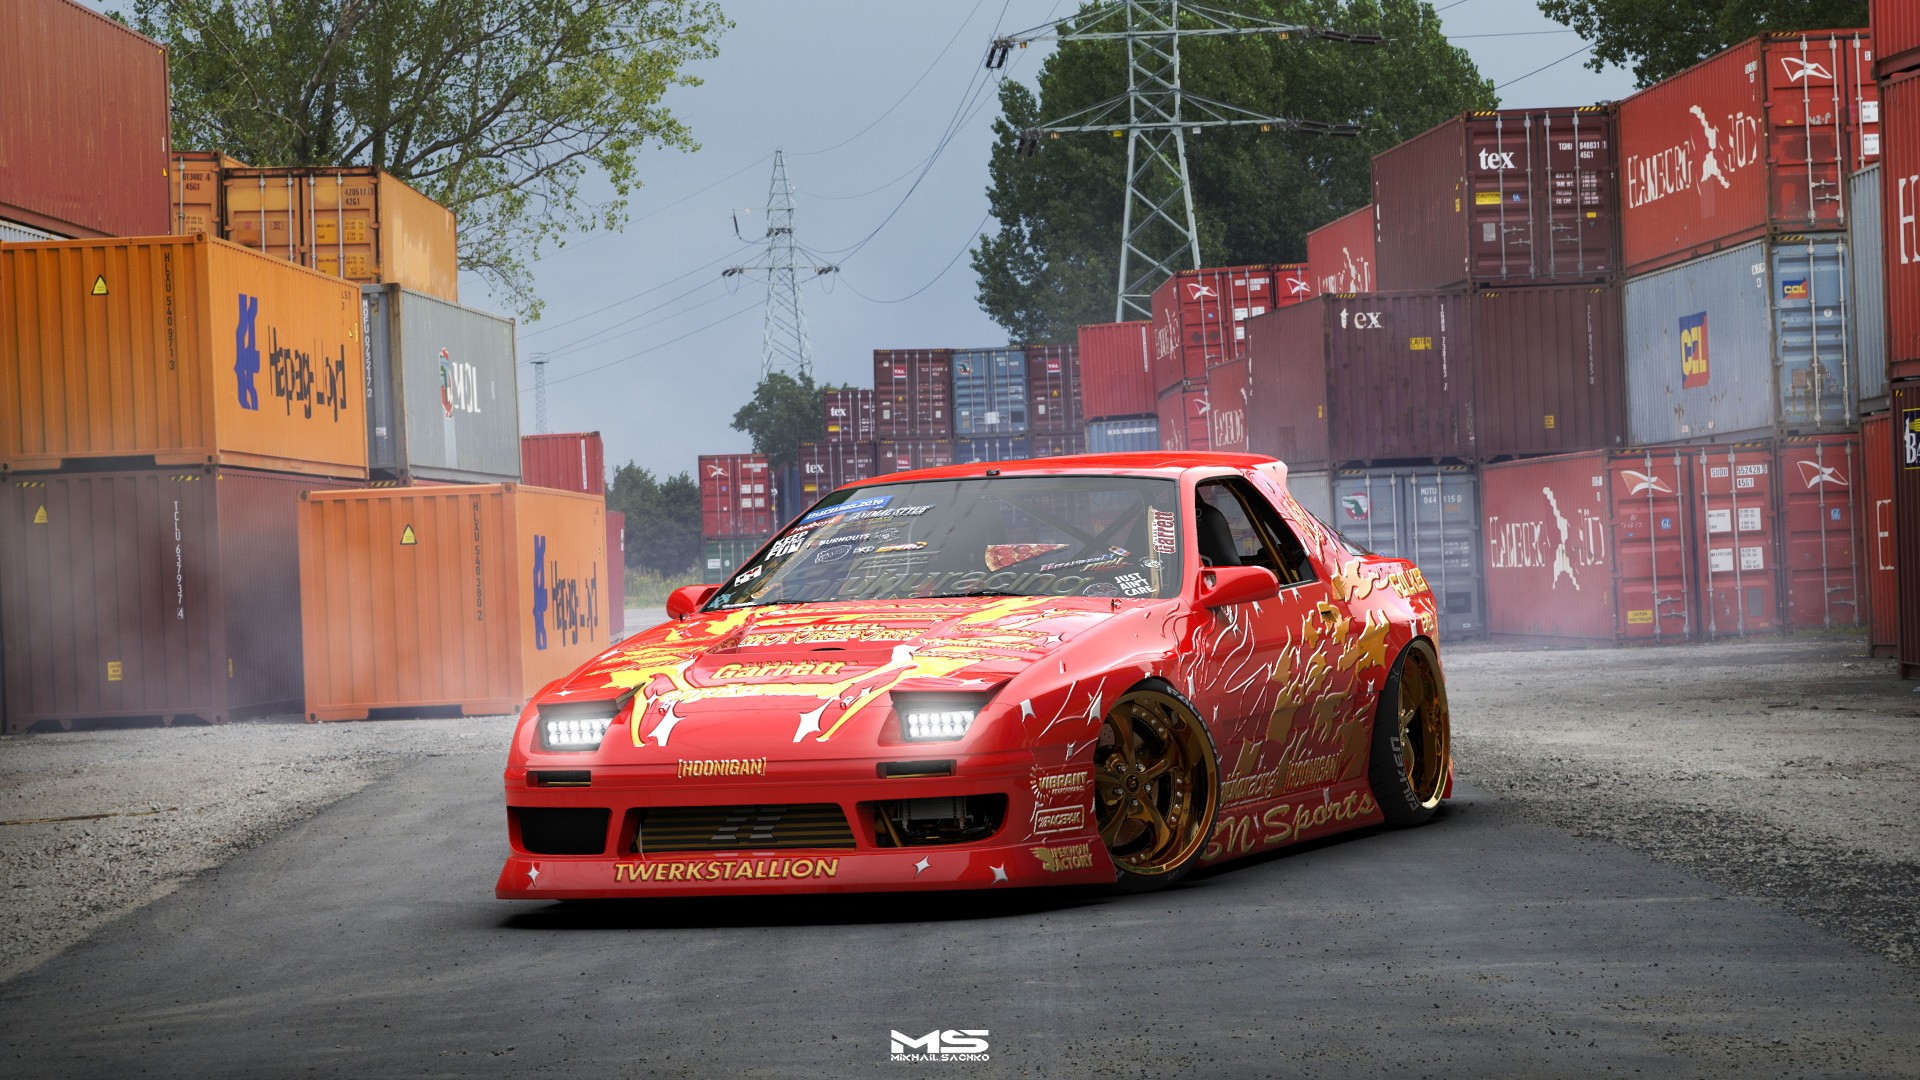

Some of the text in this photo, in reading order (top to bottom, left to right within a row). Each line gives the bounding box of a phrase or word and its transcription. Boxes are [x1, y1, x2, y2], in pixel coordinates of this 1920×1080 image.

[1479, 148, 1515, 170] tex
[1340, 307, 1382, 329] tex
[830, 406, 847, 417] tex
[805, 462, 825, 474] tex
[1711, 468, 1728, 477] SUDU
[1737, 479, 1753, 487] 45G1
[1662, 519, 1671, 527] GL
[1155, 511, 1175, 553] Garrett
[819, 533, 870, 546] BURNOUTS
[1114, 572, 1140, 584] JUST
[1119, 579, 1149, 590] AIN'T
[1124, 585, 1157, 597] CARE
[709, 660, 848, 679] Garrett
[1038, 771, 1089, 789] VIBRANT
[1263, 790, 1377, 844] Sports
[614, 857, 840, 883] TWERKSTALLION
